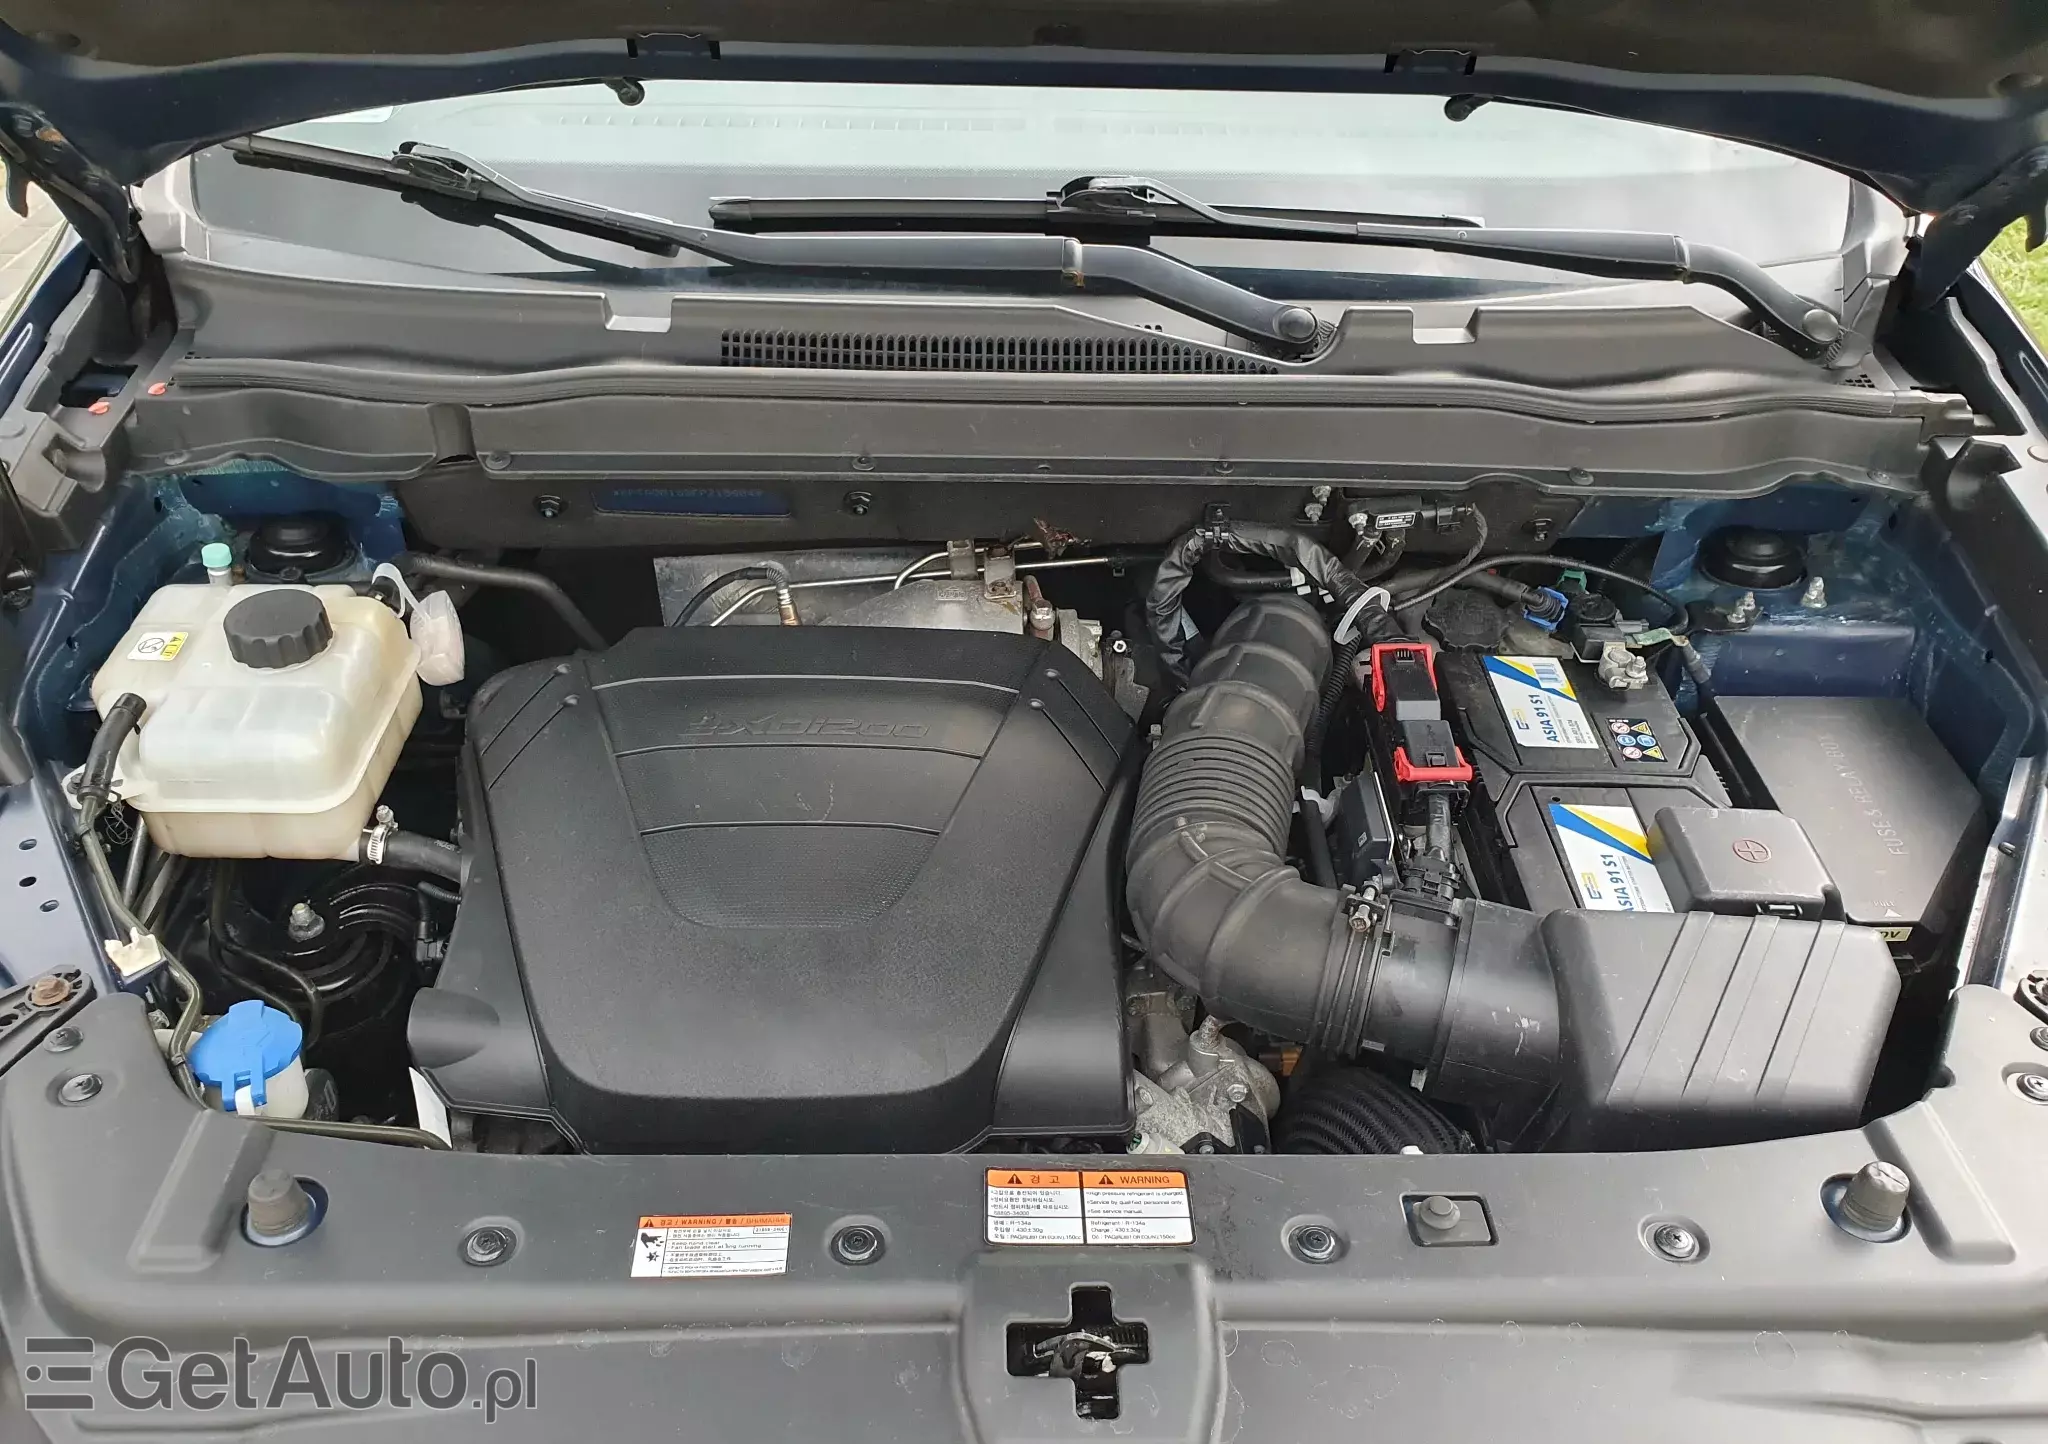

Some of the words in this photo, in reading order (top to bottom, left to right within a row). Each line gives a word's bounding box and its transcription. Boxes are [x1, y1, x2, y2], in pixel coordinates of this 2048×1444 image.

[1528, 694, 1543, 704] S1
[1534, 707, 1548, 717] 91
[1540, 720, 1560, 742] ASIA
[1833, 764, 1874, 803] RELAY
[1871, 819, 1909, 856] FUSE
[1600, 854, 1617, 867] S1
[1607, 871, 1624, 883] 91
[1120, 1176, 1170, 1184] WARNING
[681, 1218, 717, 1226] WARNING
